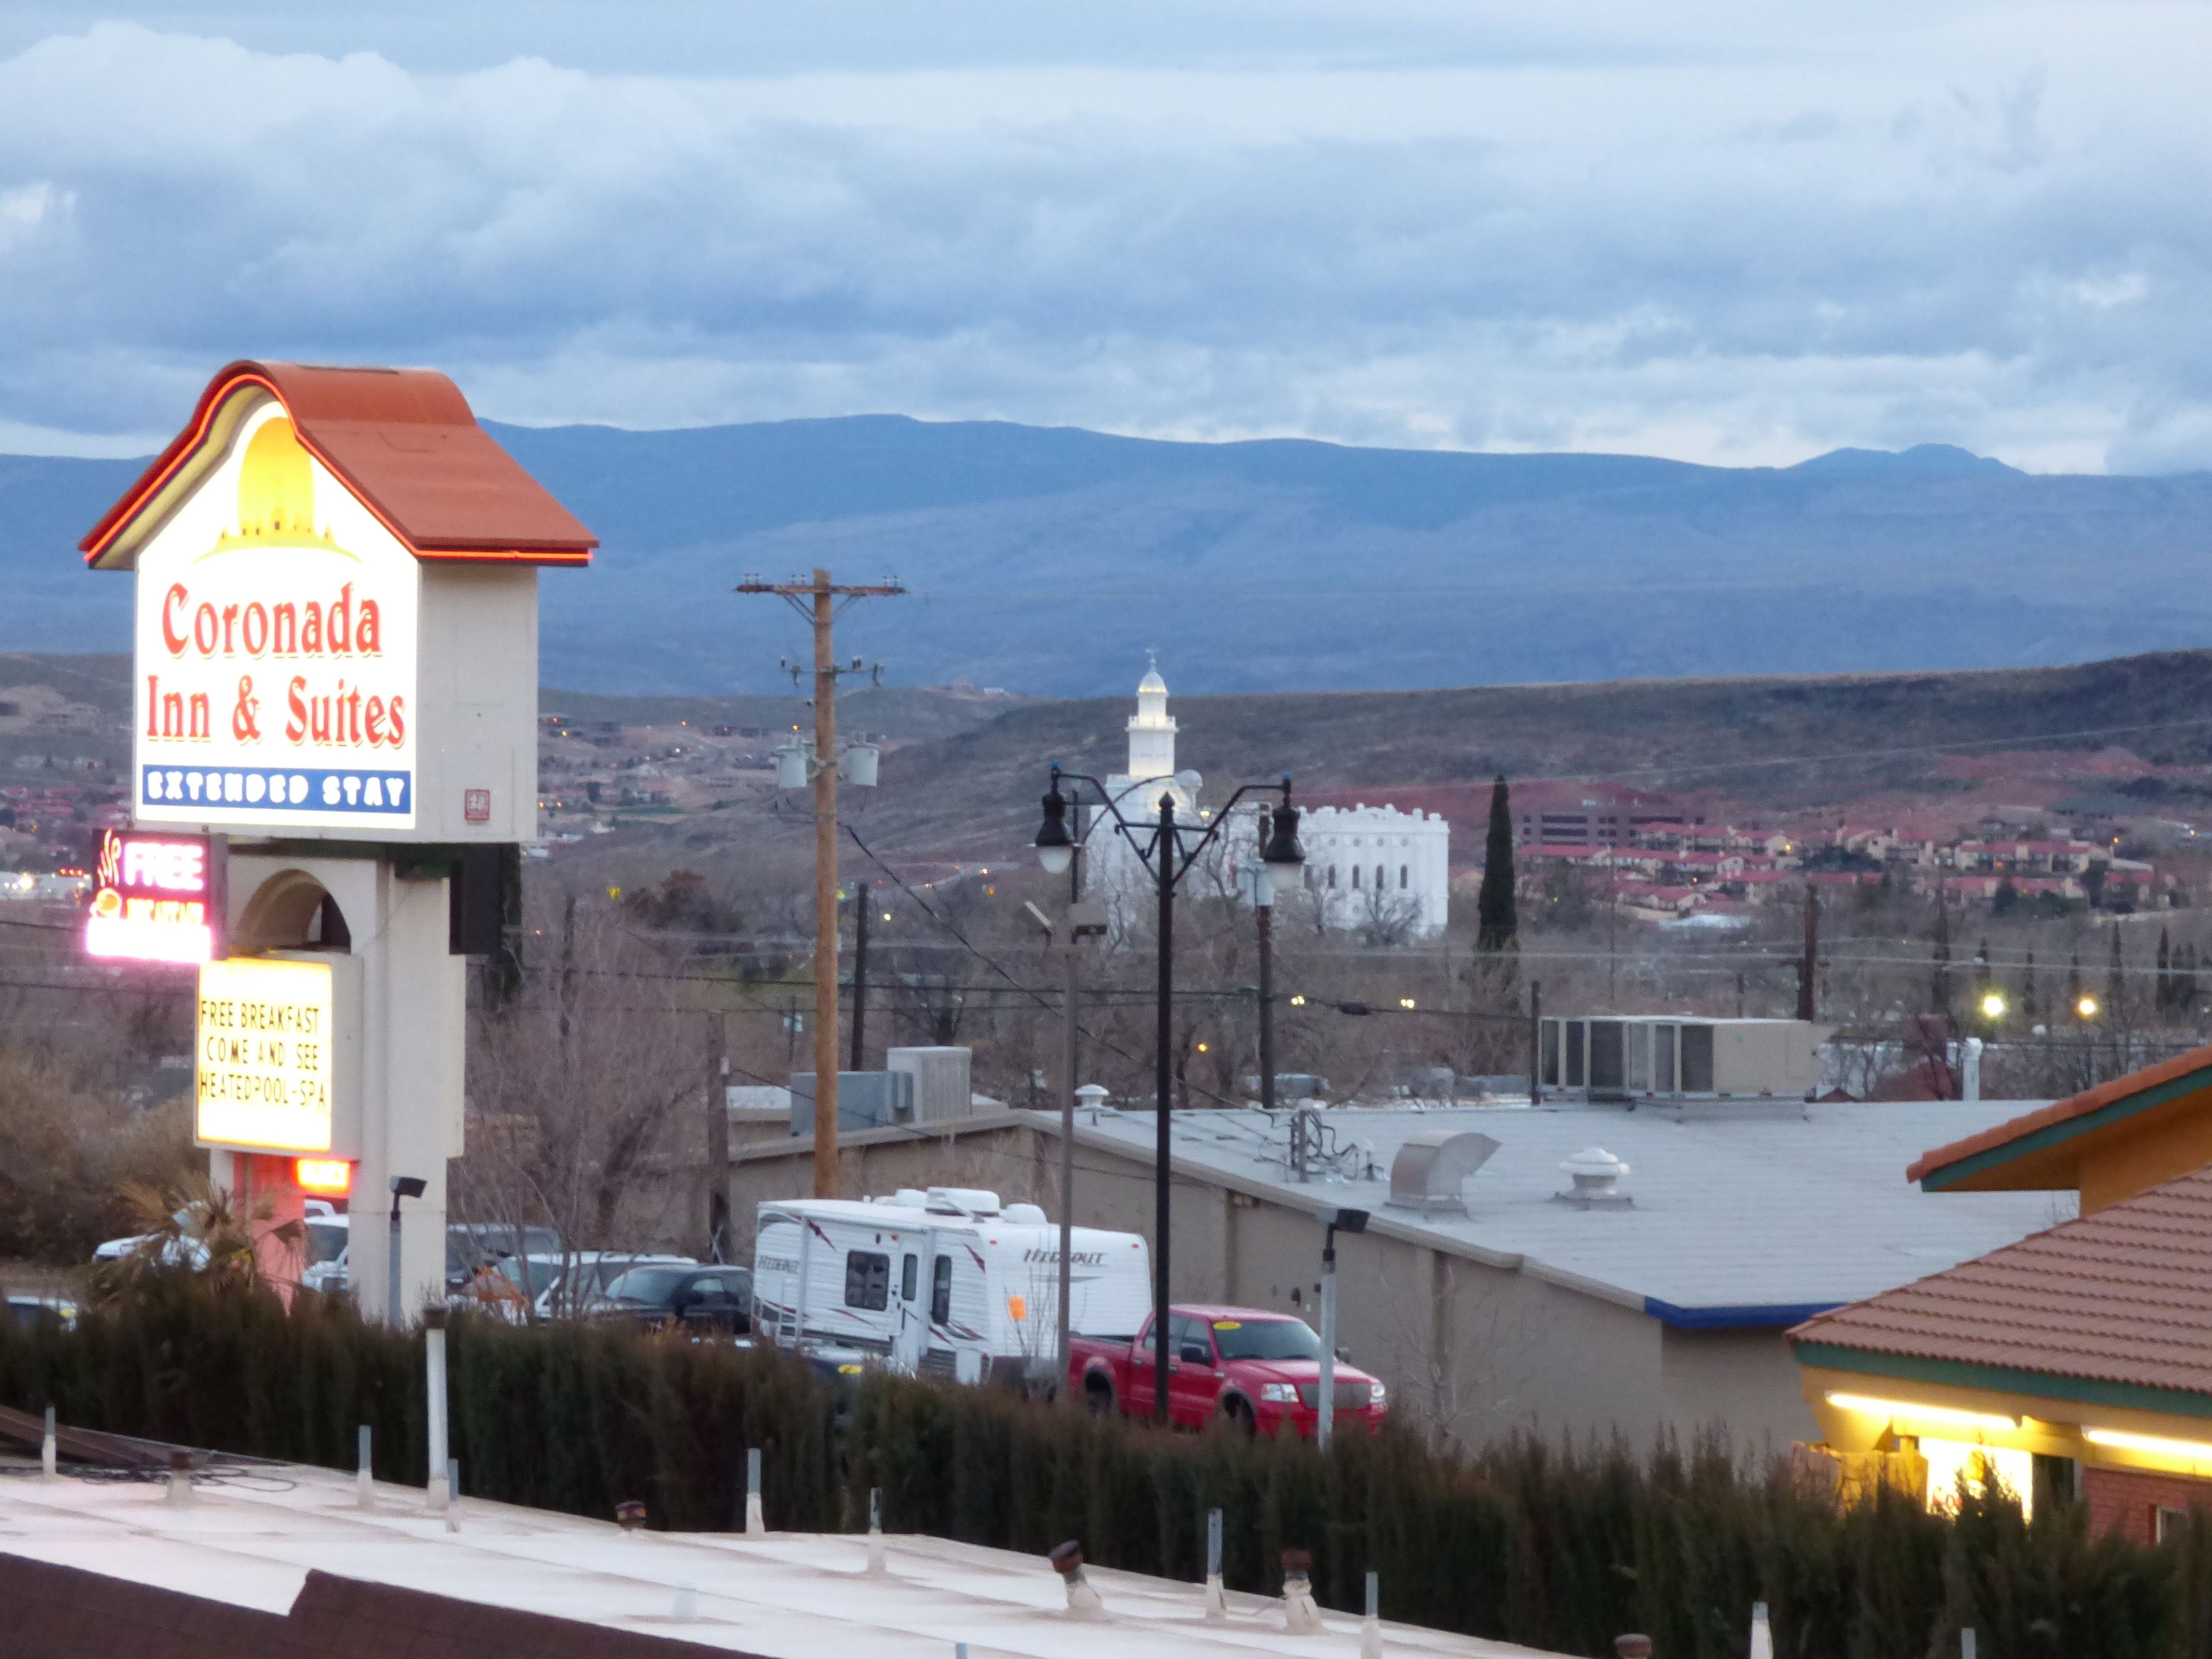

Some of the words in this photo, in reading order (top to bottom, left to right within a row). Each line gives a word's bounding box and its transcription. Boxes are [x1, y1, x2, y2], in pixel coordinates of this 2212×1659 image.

[162, 581, 382, 659] Coronada
[146, 674, 211, 741] Inn
[232, 674, 263, 744] &
[285, 675, 406, 748] Suites
[147, 771, 309, 804] EXTENDED
[322, 775, 404, 806] STAY
[201, 1000, 234, 1028] FREE
[241, 1002, 319, 1033] BREAKFAST
[207, 1036, 248, 1065] COME
[258, 1041, 285, 1067] AND
[296, 1044, 318, 1071] SEE
[1023, 1248, 1109, 1264] HIDOUT
